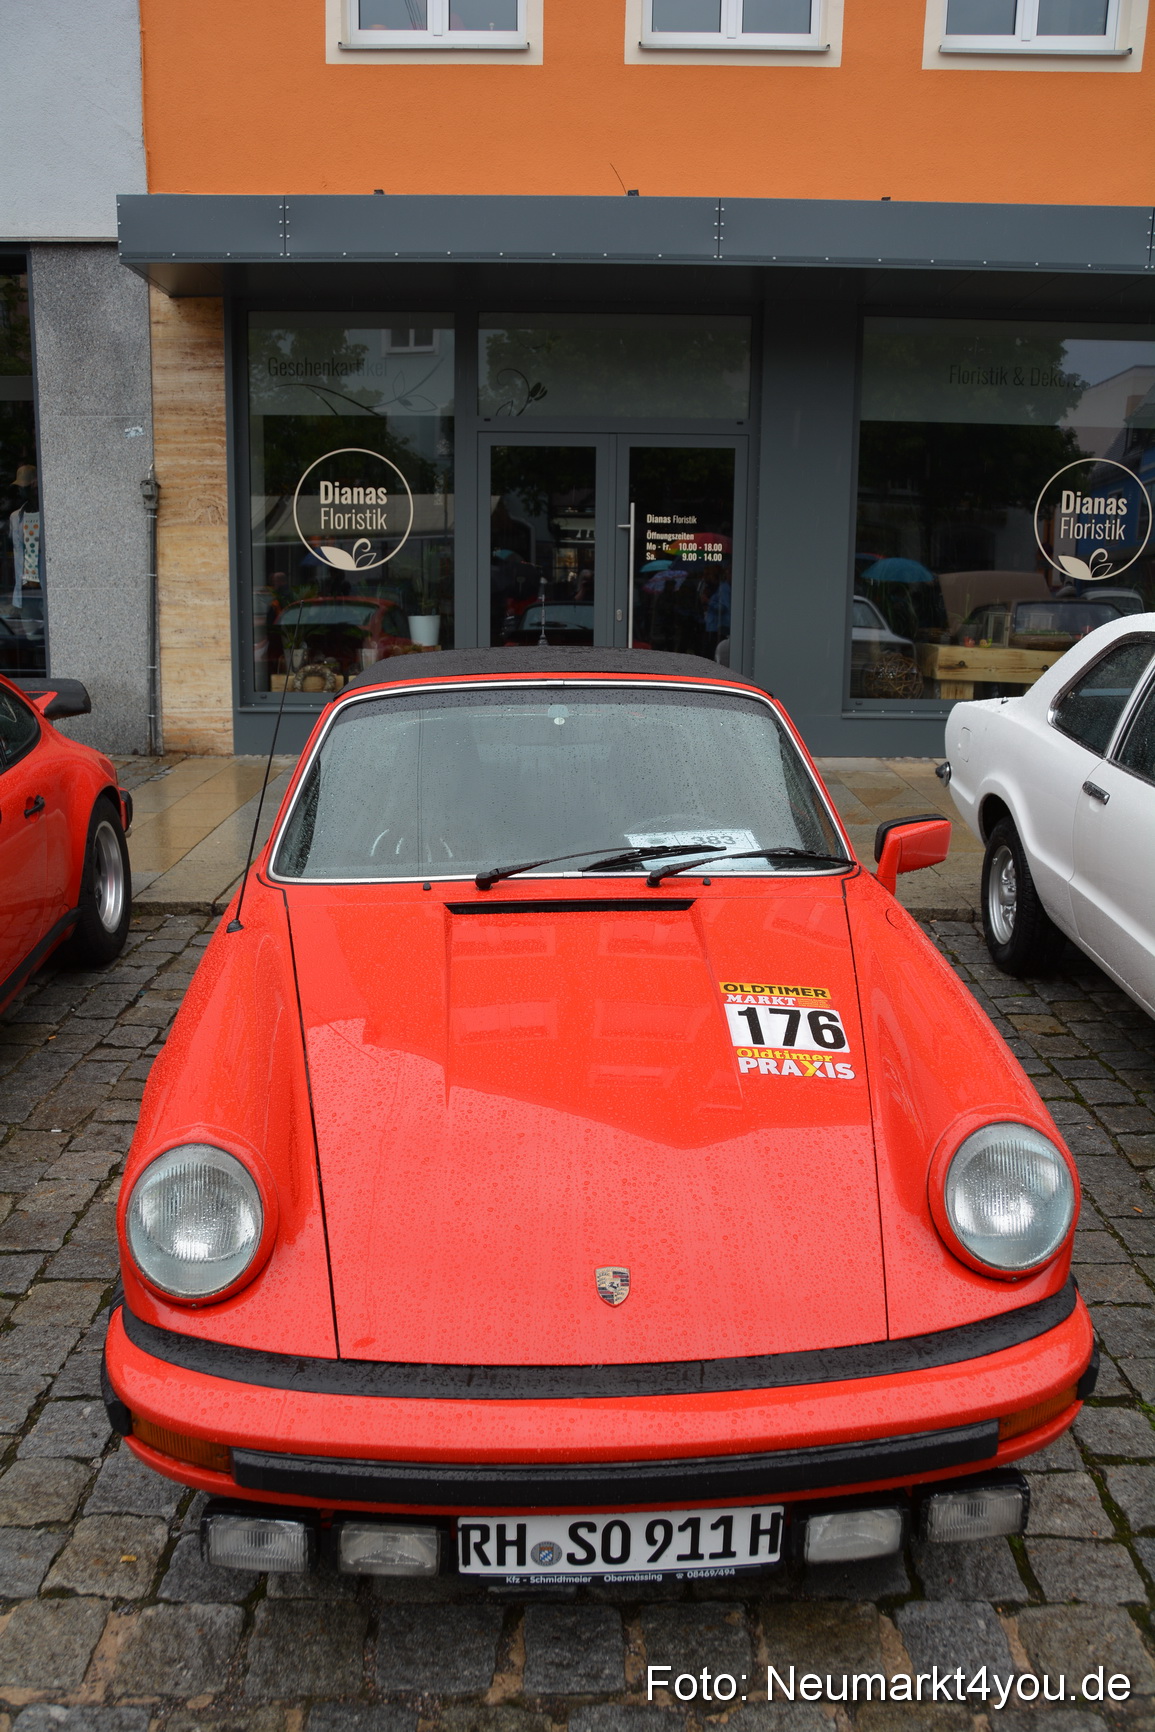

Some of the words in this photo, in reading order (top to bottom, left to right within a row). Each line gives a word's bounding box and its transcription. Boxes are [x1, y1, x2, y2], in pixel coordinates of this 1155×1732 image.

[267, 357, 388, 377] Geschenkartikel
[950, 365, 1007, 385] Floristik
[1013, 367, 1024, 386] &
[319, 480, 388, 505] Dianas
[1061, 490, 1128, 516] Dianas
[320, 507, 387, 530] Floristik
[646, 514, 671, 524] Dianas
[672, 515, 697, 524] Floristik
[646, 530, 695, 541] Öffnungszeiten
[1060, 517, 1126, 541] Floristik
[646, 542, 656, 551] Mo
[662, 543, 671, 551] Fr.
[678, 543, 697, 551] 10.00
[703, 543, 723, 551] 18.00
[646, 552, 656, 560] Sa.
[682, 553, 697, 561] 9.00
[703, 553, 723, 562] 14.00
[690, 835, 736, 845] 383
[723, 983, 828, 998] OLDTIMER
[726, 994, 796, 1006] MARKT
[737, 1006, 846, 1050] 176
[736, 1048, 833, 1062] Oldtimer
[461, 1523, 527, 1566] RH
[566, 1519, 632, 1566] SO
[506, 1576, 521, 1584] Kfz
[686, 1568, 736, 1579] 08469/494
